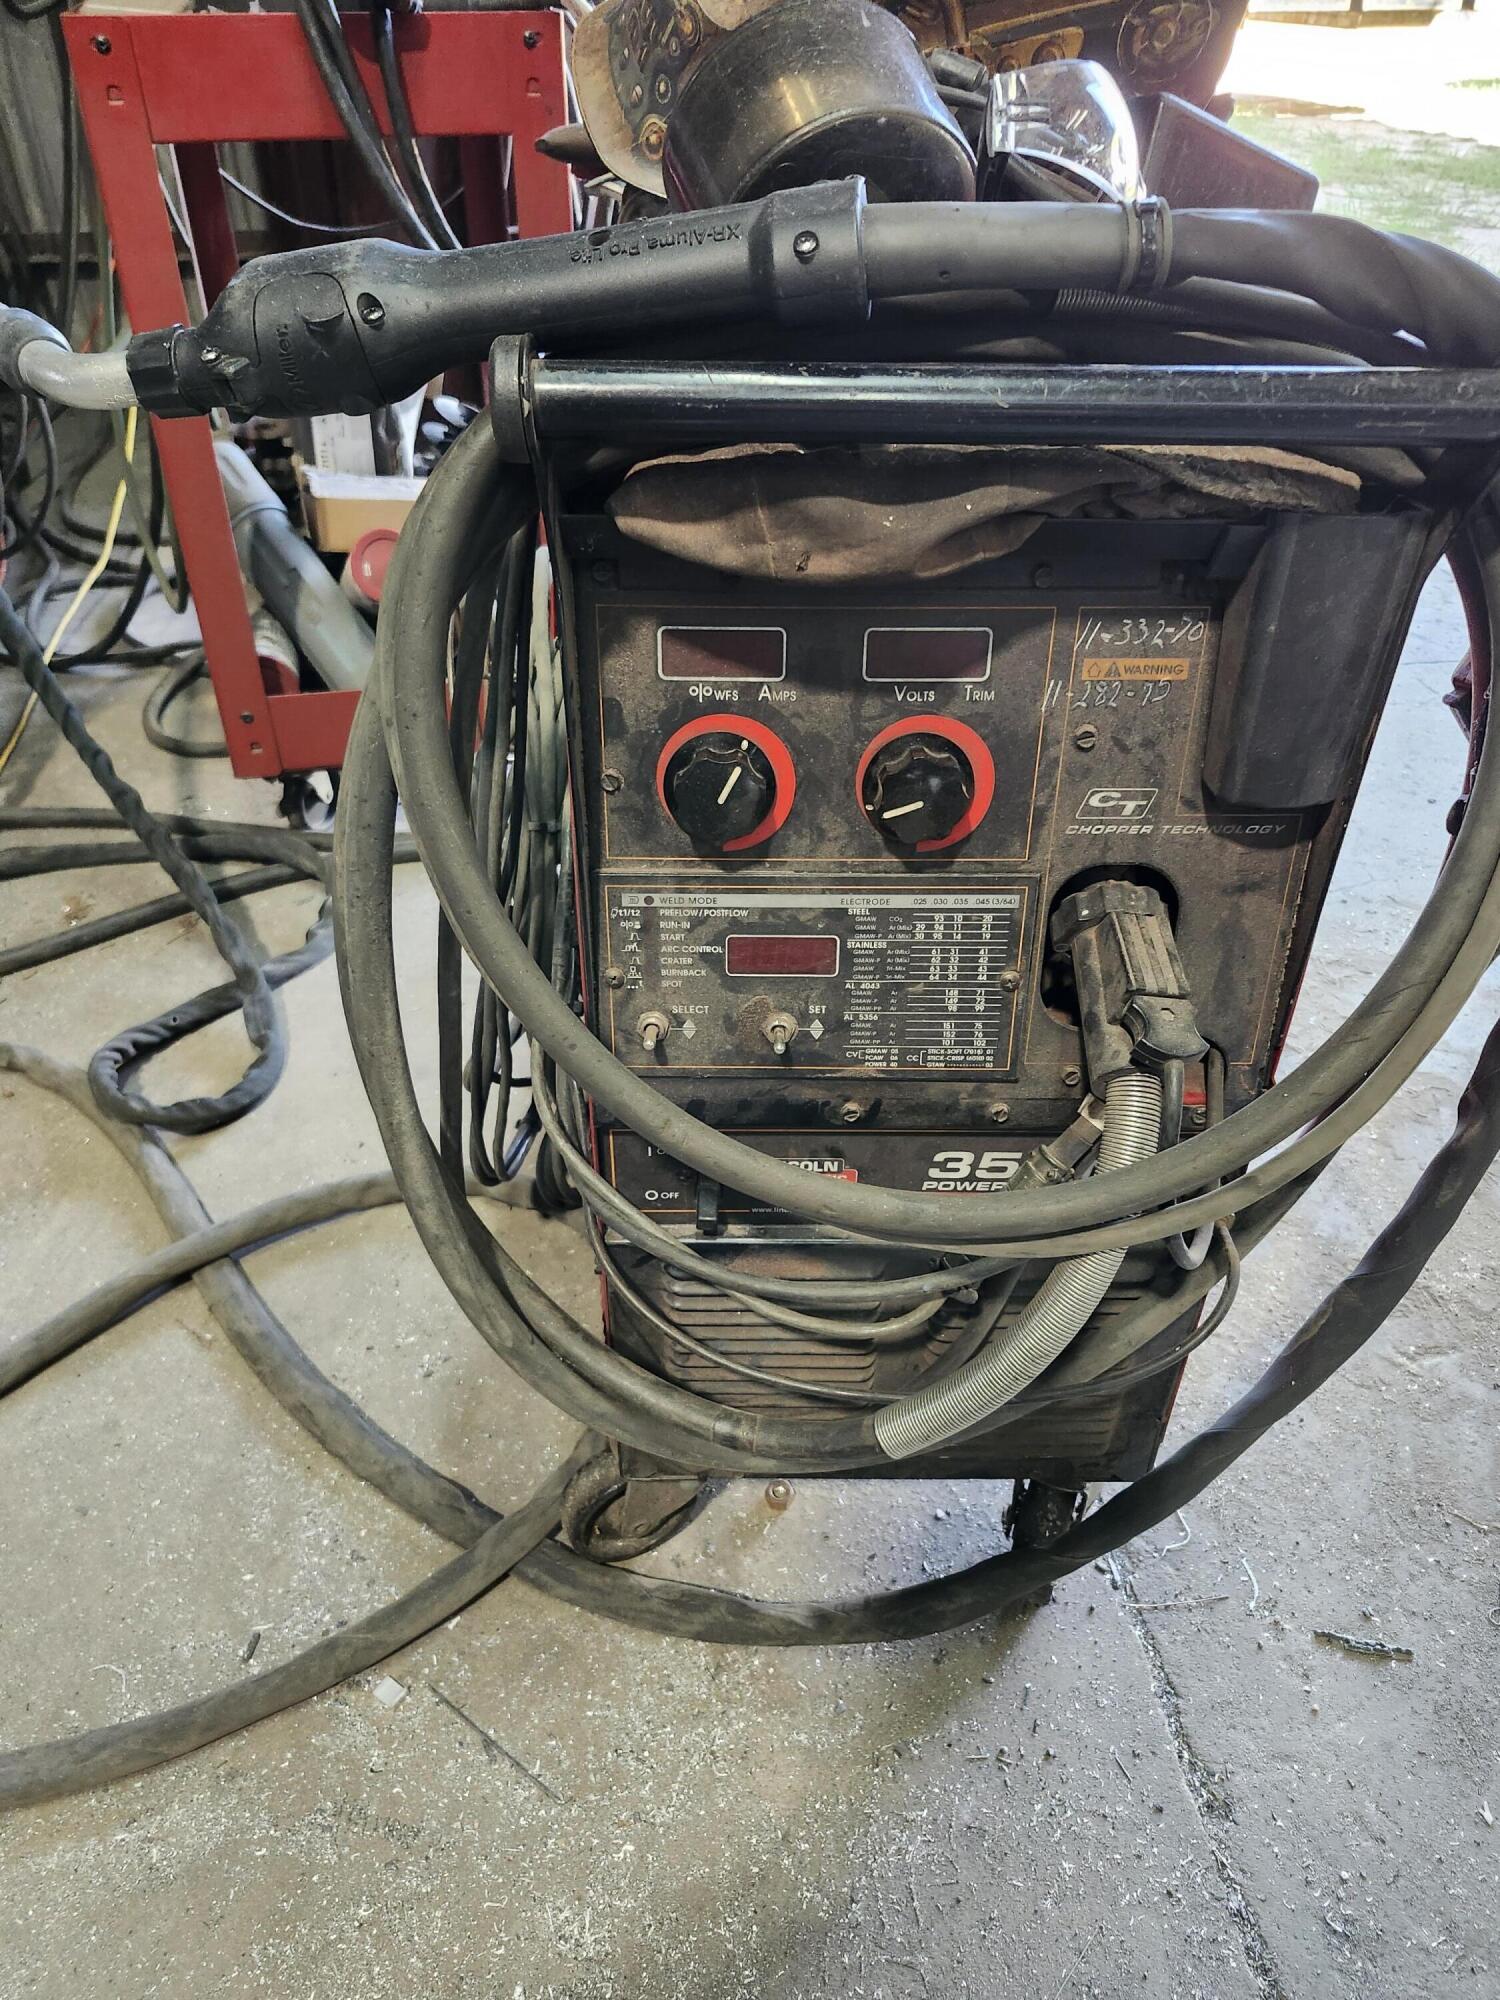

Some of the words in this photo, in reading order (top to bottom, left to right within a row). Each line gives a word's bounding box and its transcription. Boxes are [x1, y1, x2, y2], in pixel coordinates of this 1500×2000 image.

[646, 224, 741, 250] XR-Aluma
[609, 243, 641, 257] Pro
[1123, 663, 1185, 676] WARNING
[713, 689, 739, 701] WFS
[1087, 791, 1148, 817] CT
[1065, 825, 1154, 835] CHOPPER
[1161, 824, 1287, 835] TECHNOLOGY
[659, 896, 685, 905] WELD
[688, 896, 718, 905] MODE
[840, 898, 891, 906] ELECTRODE
[847, 908, 871, 916] STEEL
[854, 915, 877, 923] GMAW
[934, 915, 944, 923] 93
[953, 915, 963, 923] 10
[982, 915, 993, 923] 20
[659, 921, 691, 929] RUN-IN
[660, 933, 685, 941] START
[660, 945, 680, 953] ARC
[681, 945, 724, 953] CONTROL
[846, 941, 888, 949] STAINLESS
[660, 957, 693, 965] CRATER
[661, 969, 707, 977] BURNBACK
[661, 980, 682, 988] SPOT
[671, 1005, 710, 1014] SELECT
[808, 1005, 827, 1014] SET
[843, 1013, 855, 1021] AL
[858, 1013, 879, 1021] 5356
[906, 1054, 919, 1062] CC
[660, 1191, 680, 1199] OFF
